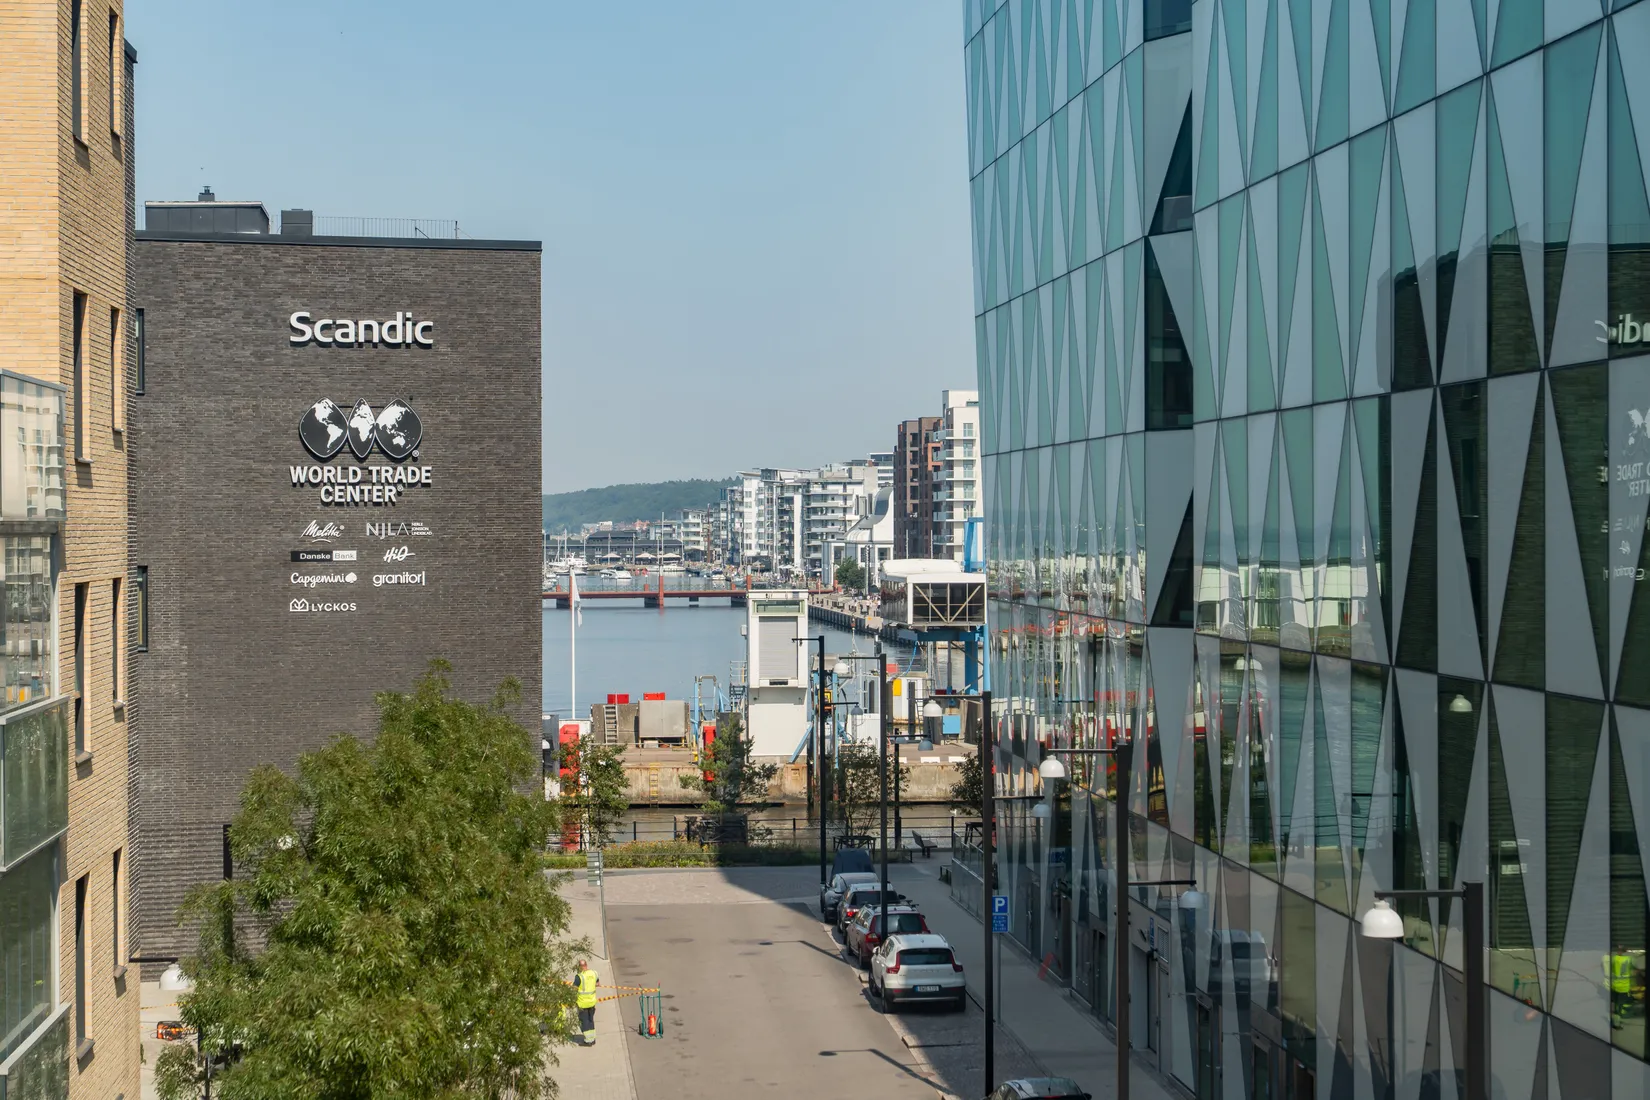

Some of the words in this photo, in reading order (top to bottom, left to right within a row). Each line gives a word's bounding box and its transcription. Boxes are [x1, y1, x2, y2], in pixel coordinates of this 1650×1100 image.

[289, 311, 434, 345] Scandic
[289, 465, 362, 484] WORLD
[368, 465, 433, 484] TRADE
[300, 519, 342, 539] Melitta
[366, 522, 410, 540] NJLA
[299, 552, 331, 560] Danske
[334, 552, 355, 560] Bank
[290, 572, 345, 588] Capgemini
[311, 602, 357, 612] LYCKOS
[994, 897, 1006, 913] P
